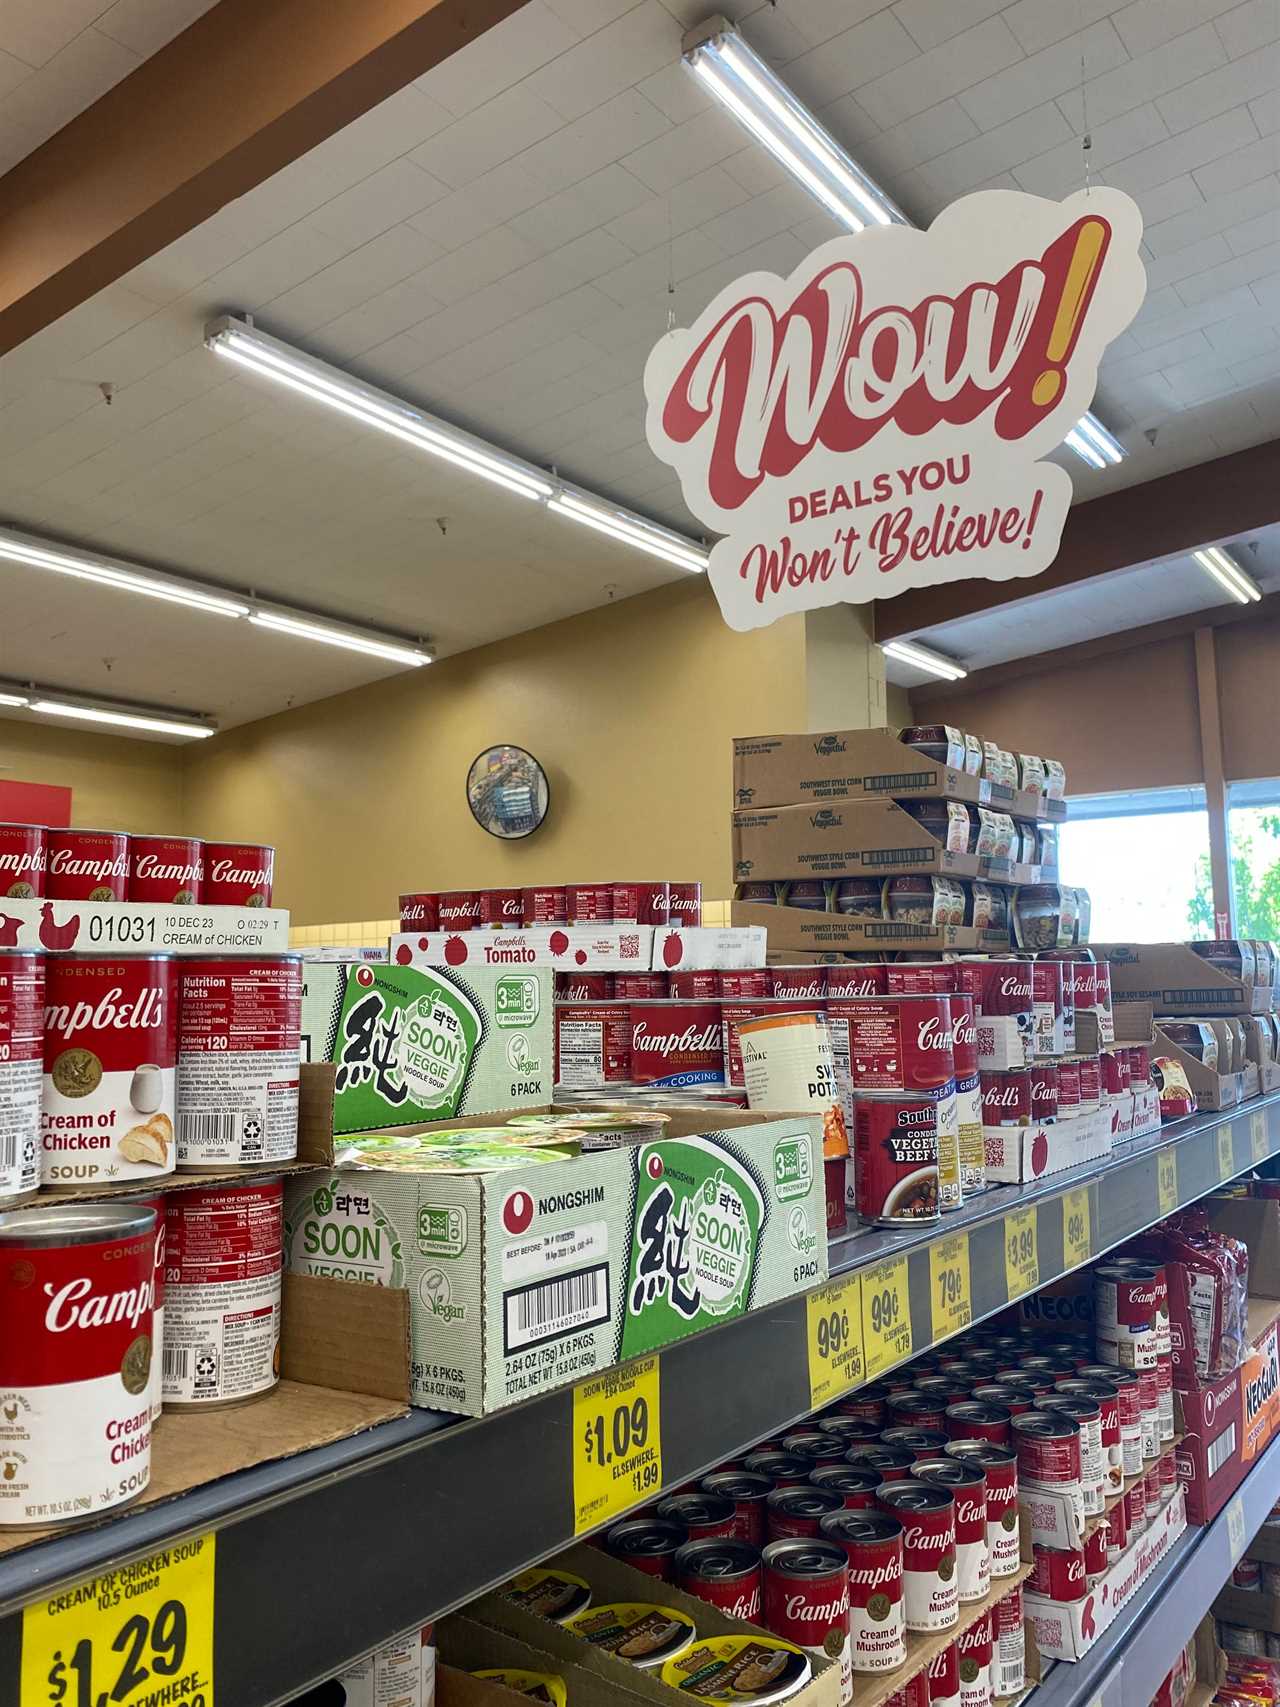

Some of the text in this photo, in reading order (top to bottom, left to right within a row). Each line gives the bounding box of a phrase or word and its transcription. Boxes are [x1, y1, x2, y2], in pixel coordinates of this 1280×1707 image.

[662, 214, 1112, 510] Wow!
[788, 454, 972, 524] DEALS YOU
[740, 489, 1044, 603] Won't Believe!
[89, 915, 156, 942] 01031
[165, 917, 176, 928] 10
[178, 917, 200, 928] DEC
[201, 918, 214, 929] 23
[162, 933, 263, 946] CREAM of CHICKEN
[484, 947, 536, 964] Tomato
[183, 976, 226, 988] Nutrition
[183, 988, 208, 998] Facts
[497, 987, 508, 1008] 3
[507, 998, 522, 1009] min
[207, 1036, 228, 1050] 120
[407, 1022, 459, 1064] SOON
[406, 1049, 450, 1080] VEGGIE
[403, 1065, 446, 1090] NOODLE SOUP
[511, 1081, 542, 1097] 6 PACK
[671, 1072, 718, 1087] COOKING
[97, 1110, 117, 1128] of
[43, 1133, 111, 1151] Chicken
[775, 1152, 785, 1179] 3
[895, 1149, 931, 1162] BEEF
[50, 1163, 100, 1180] SOUP
[784, 1162, 798, 1177] min
[237, 1194, 262, 1202] CHICKEN
[537, 1184, 605, 1216] NONGSHIM
[420, 1213, 432, 1236] 3
[431, 1225, 447, 1237] min
[695, 1211, 743, 1256] SOON
[1068, 1215, 1085, 1246] 99¢
[303, 1220, 381, 1261] SOON
[1007, 1227, 1034, 1268] $3.99
[506, 1247, 520, 1260] BEST
[695, 1246, 737, 1279] VEGGIE
[695, 1266, 735, 1290] NOODLE SOUP
[793, 1267, 800, 1283] 6
[938, 1267, 962, 1309] 79¢
[430, 1296, 466, 1322] Vegan
[871, 1287, 899, 1334] 99¢
[817, 1308, 849, 1359] 99¢
[505, 1332, 596, 1376] 2.64 OZ (75g) X 6 PKGS.
[1171, 1351, 1181, 1365] 6
[432, 1366, 439, 1379] 6
[440, 1367, 466, 1384] PKGS.
[505, 1375, 528, 1395] TOTAL
[528, 1370, 542, 1387] NET
[583, 1383, 600, 1399] SOON
[621, 1363, 643, 1382] NOODLE
[618, 1378, 636, 1393] Ounce
[105, 1410, 149, 1441] Cream
[584, 1396, 648, 1467] $1.09
[632, 1462, 659, 1493] $1.99
[25, 1505, 37, 1517] NET
[47, 1538, 204, 1616] CREAM OF CHICKEN SOUP
[1113, 1576, 1133, 1607] Cream
[1138, 1532, 1169, 1576] Mushroom
[97, 1575, 160, 1612] 10.5 Ounce
[856, 1638, 900, 1652] Mushroom
[860, 1625, 897, 1642] Cream of
[869, 1656, 893, 1668] SOUP
